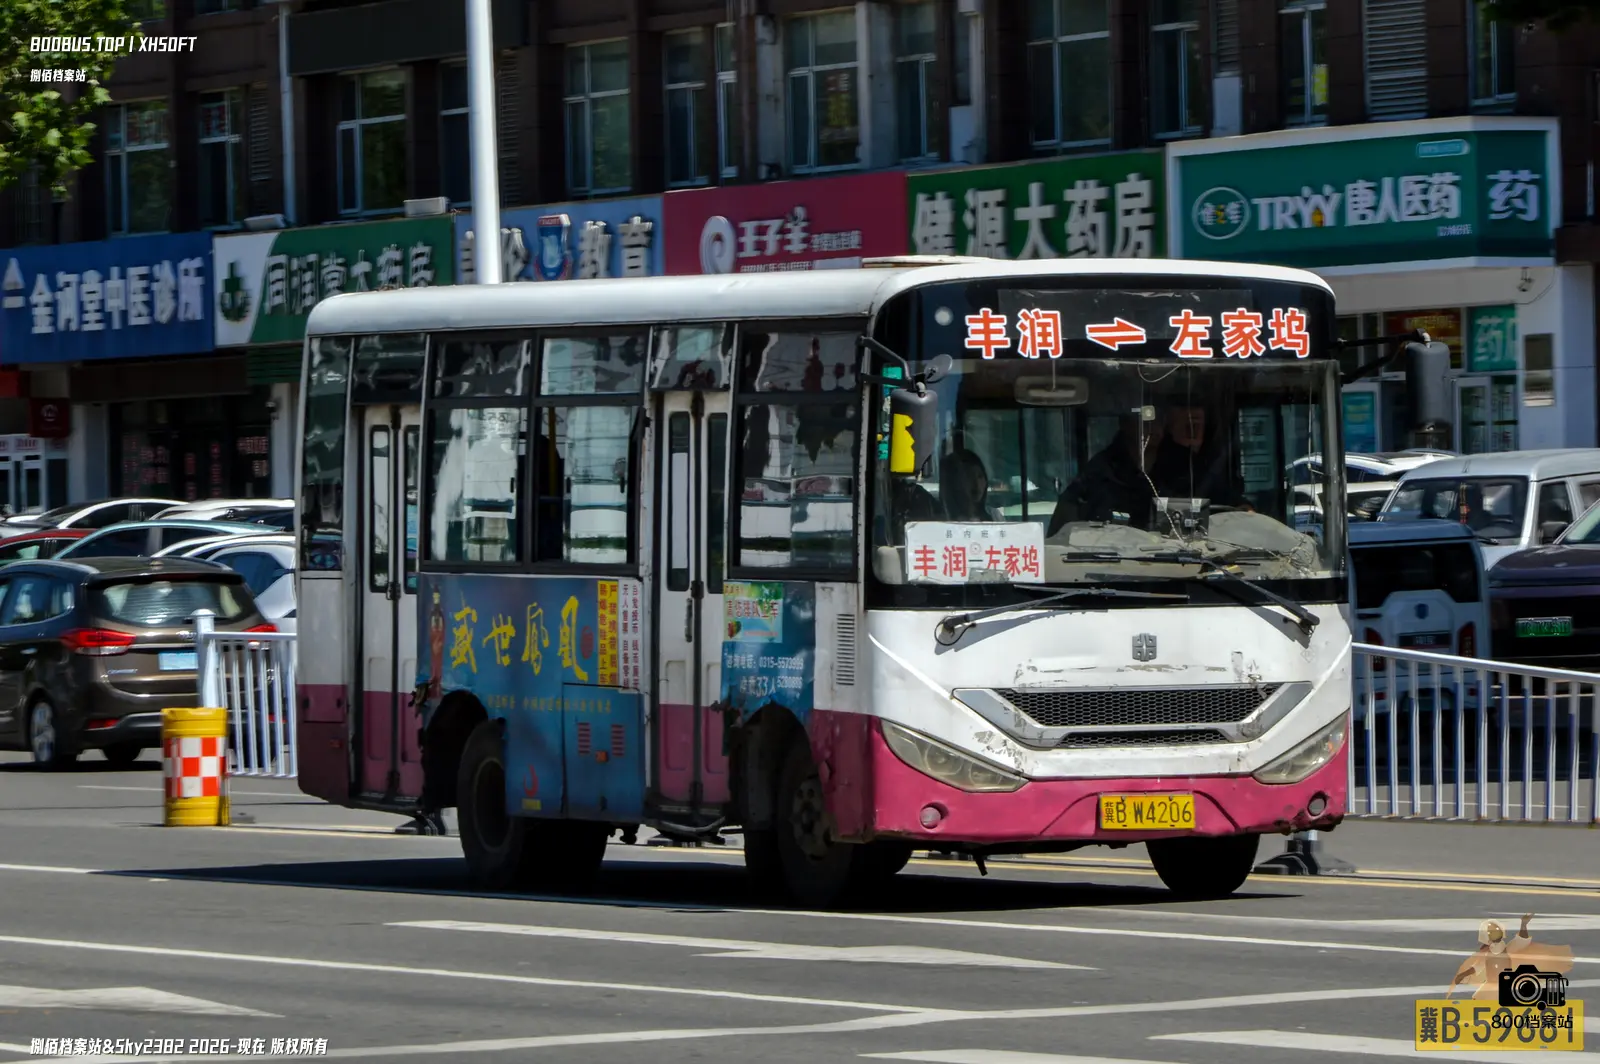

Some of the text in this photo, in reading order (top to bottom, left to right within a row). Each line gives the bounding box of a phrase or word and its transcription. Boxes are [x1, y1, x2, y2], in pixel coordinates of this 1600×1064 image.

[1345, 172, 1462, 227] 唐人医药
[1486, 170, 1541, 222] 药
[964, 308, 1311, 359] 丰润 左家坞
